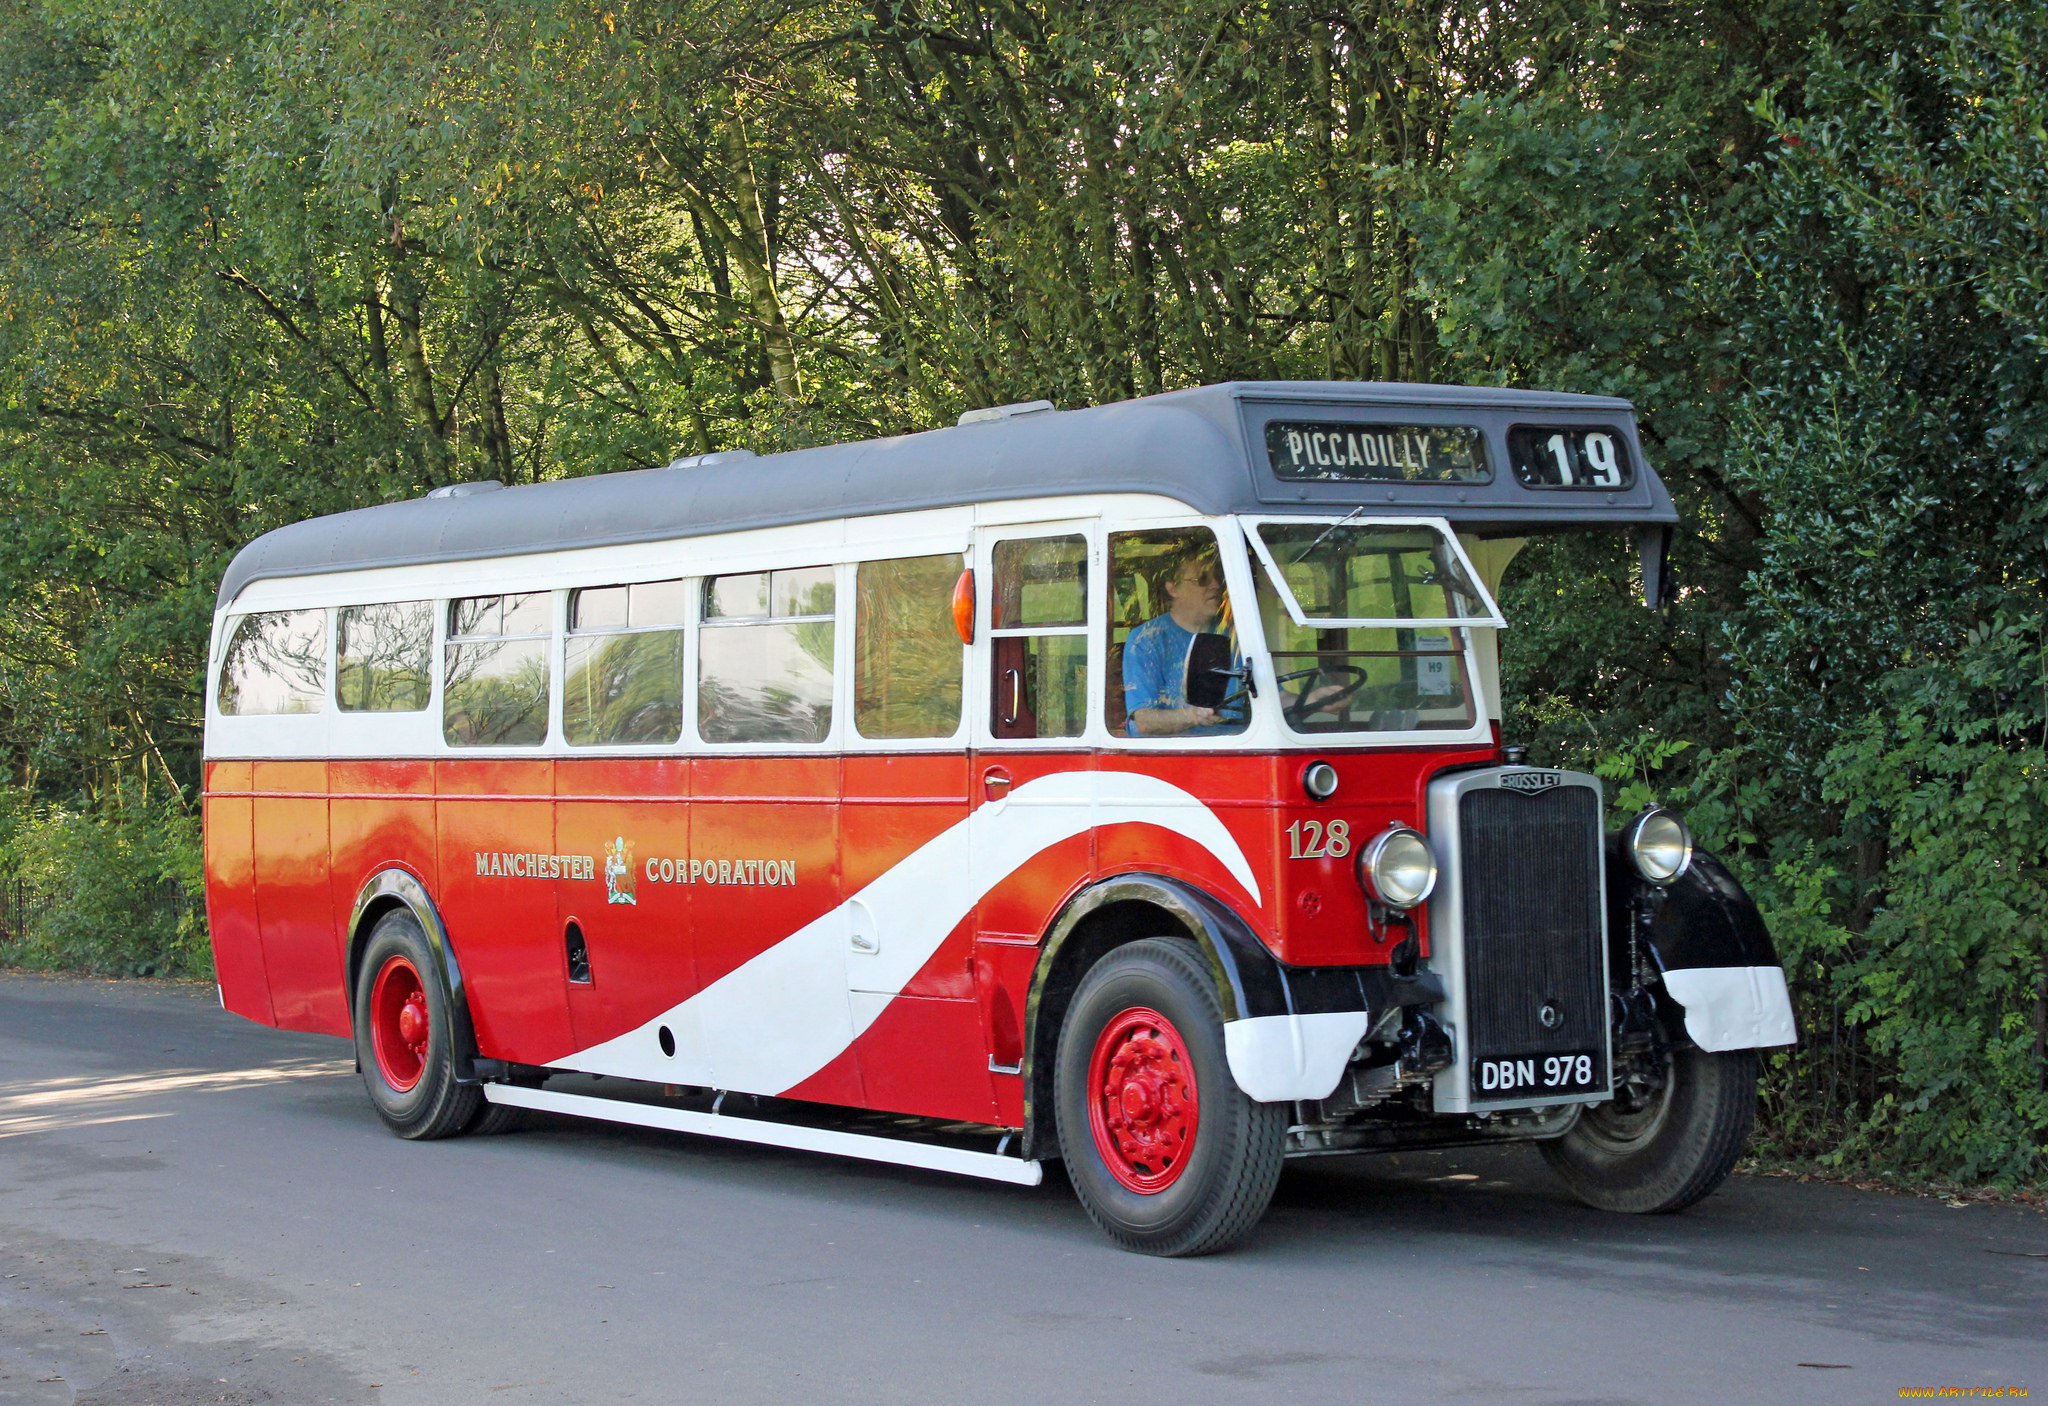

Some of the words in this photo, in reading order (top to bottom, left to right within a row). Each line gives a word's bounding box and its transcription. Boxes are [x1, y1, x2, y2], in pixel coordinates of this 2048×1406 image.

[1287, 431, 1430, 468] PICCADILLY
[1428, 661, 1443, 673] H9
[1501, 773, 1560, 789] CROSSLEY
[1285, 819, 1350, 859] 128
[475, 852, 595, 880] MANCHESTER
[645, 857, 796, 886] CORPORATION
[1482, 1059, 1535, 1090] DBN
[1543, 1055, 1592, 1086] 978
